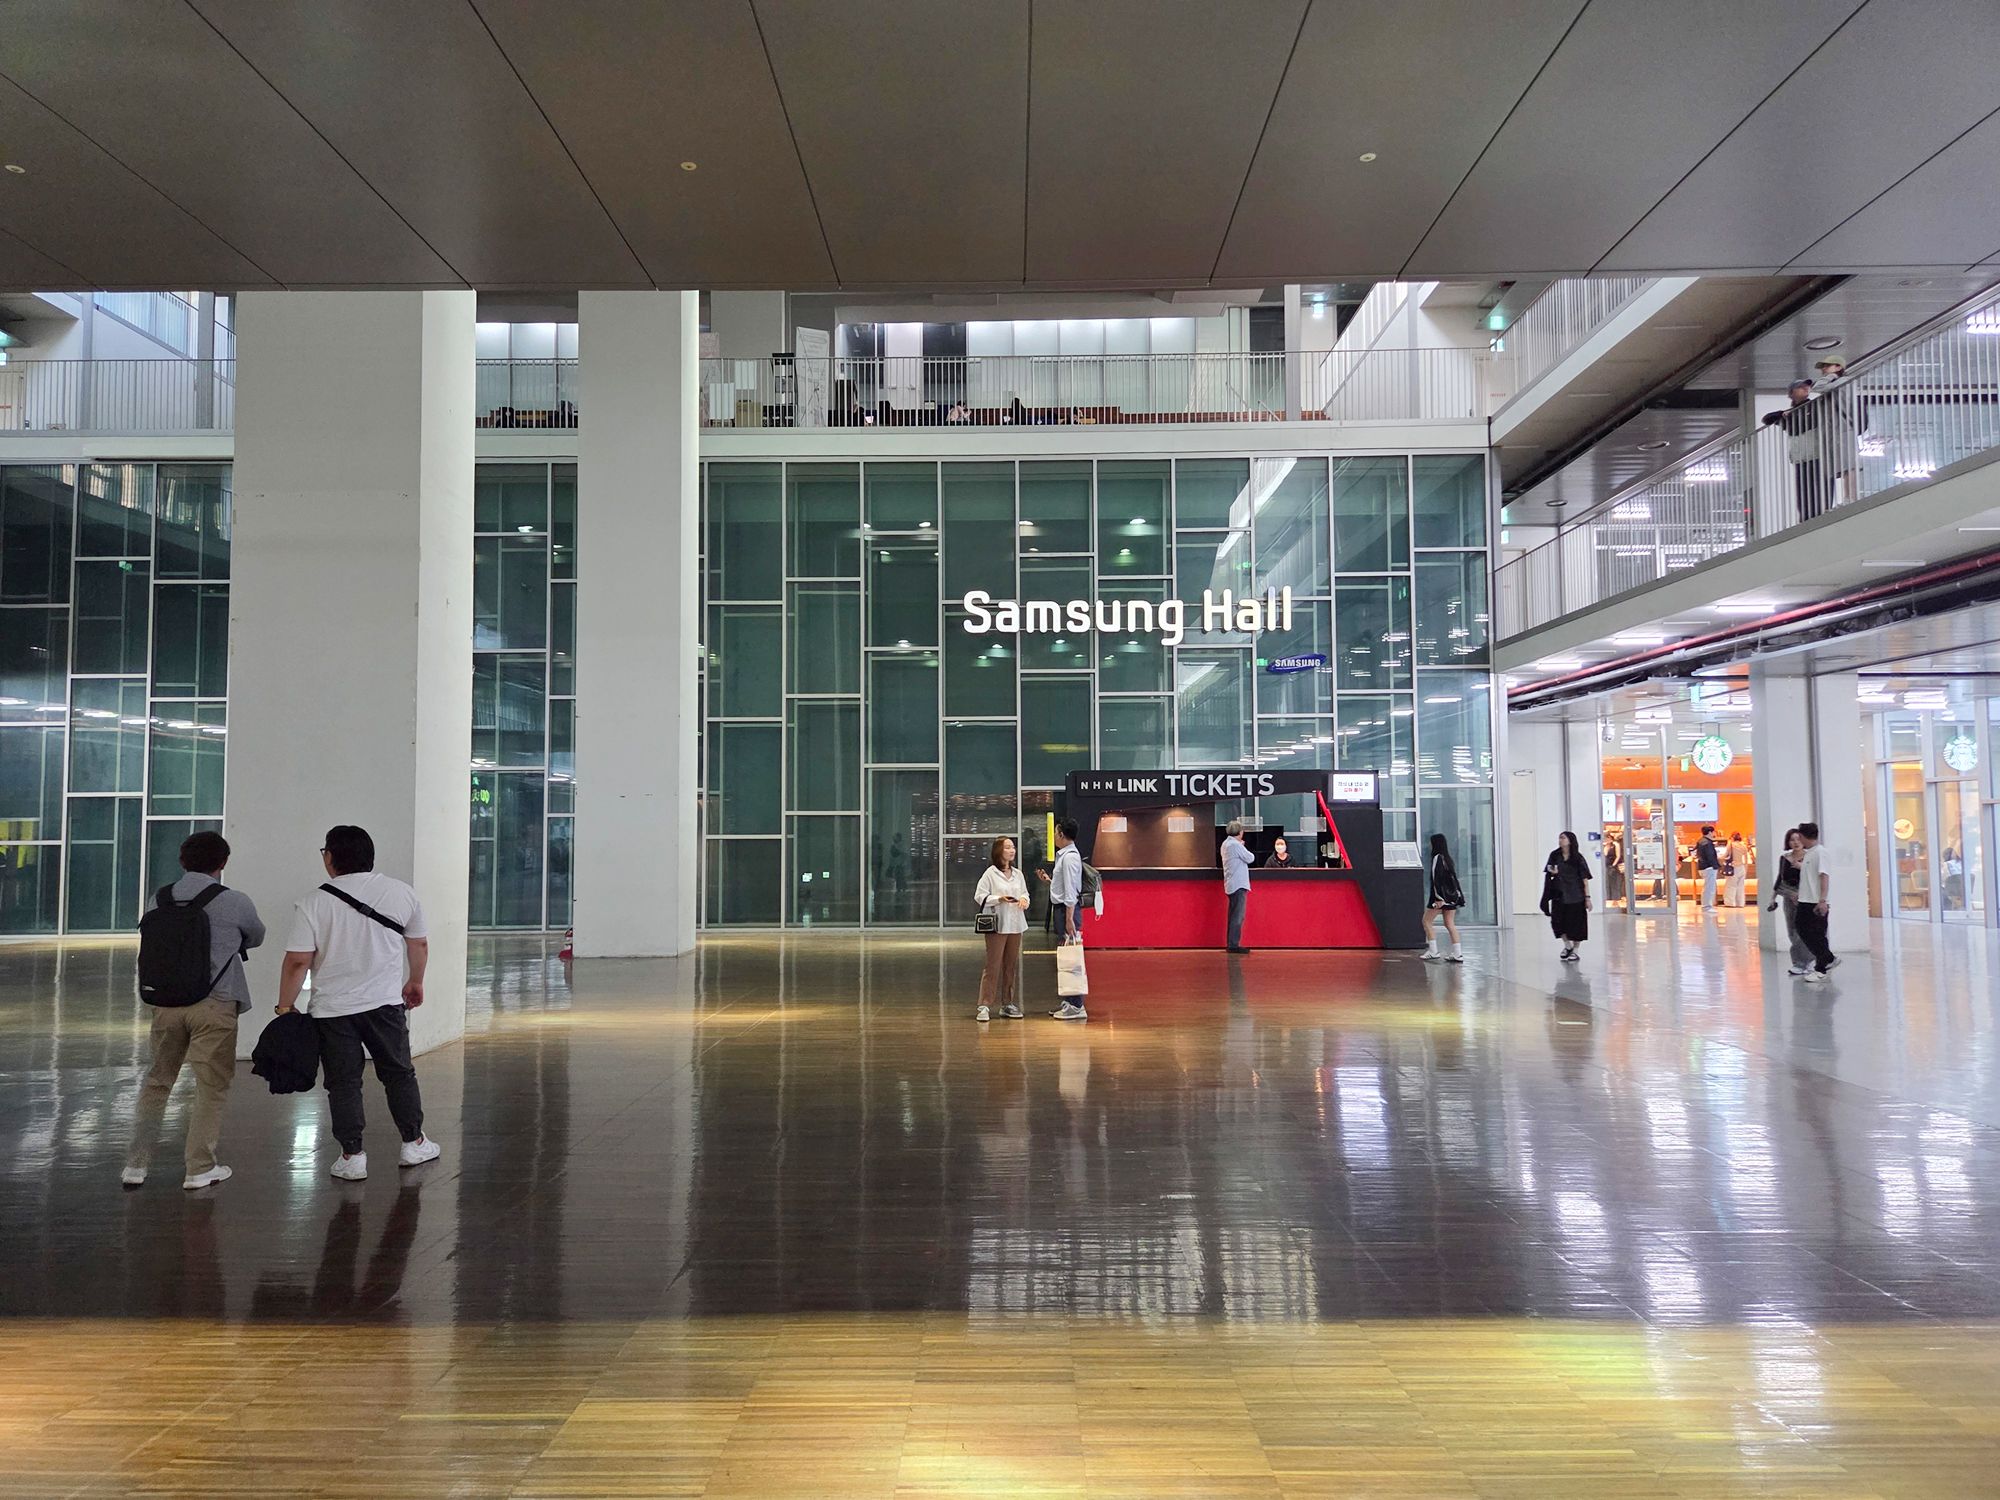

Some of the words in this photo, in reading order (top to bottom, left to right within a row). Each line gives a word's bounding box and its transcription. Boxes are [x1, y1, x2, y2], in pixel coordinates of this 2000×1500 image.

[963, 590, 1184, 647] Samsung
[1203, 585, 1292, 632] Hall
[1275, 659, 1321, 667] SAMSUNG
[1117, 778, 1158, 793] LINK
[1164, 774, 1275, 796] TICKETS
